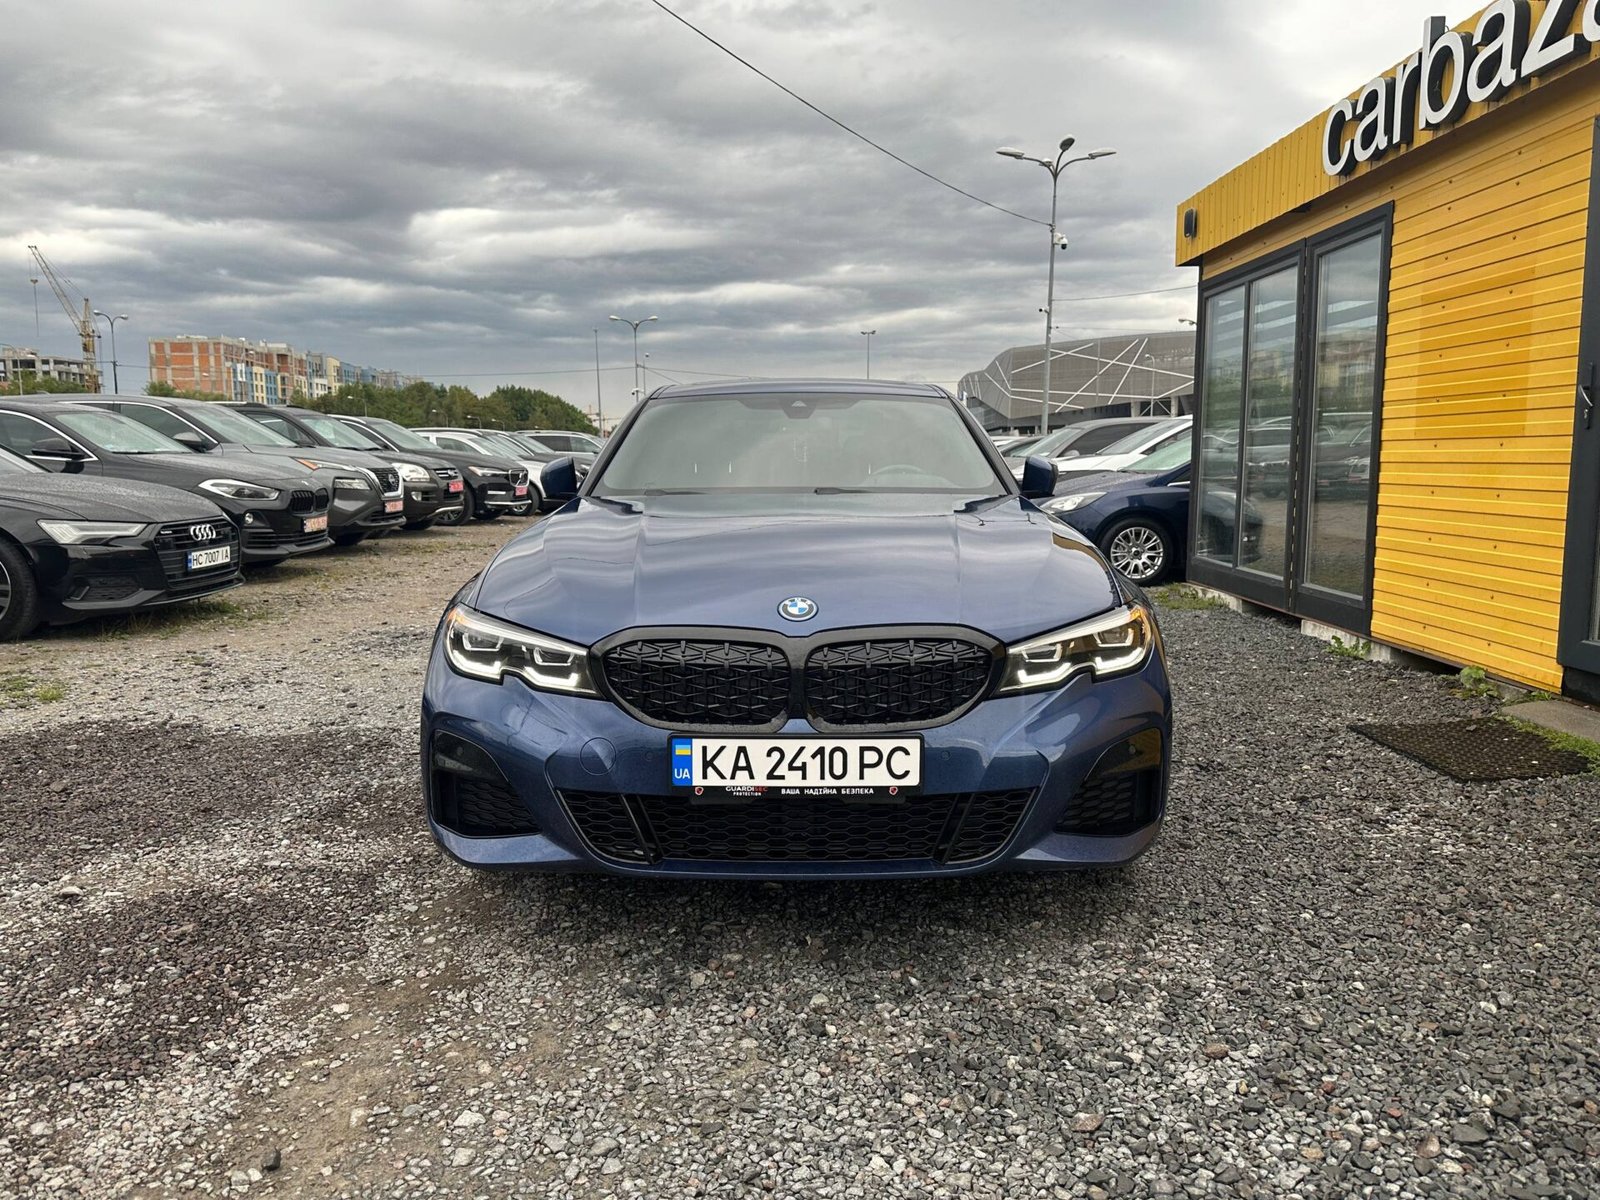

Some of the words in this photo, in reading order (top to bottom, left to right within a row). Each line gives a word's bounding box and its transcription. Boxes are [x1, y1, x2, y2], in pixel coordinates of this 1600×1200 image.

[192, 553, 203, 567] HC
[204, 550, 220, 565] 7007
[221, 548, 229, 560] IA
[701, 745, 755, 780] KA
[765, 745, 848, 780] 2410
[858, 745, 911, 780] PC
[674, 768, 691, 779] UA
[804, 787, 837, 795] НАДІЙНА
